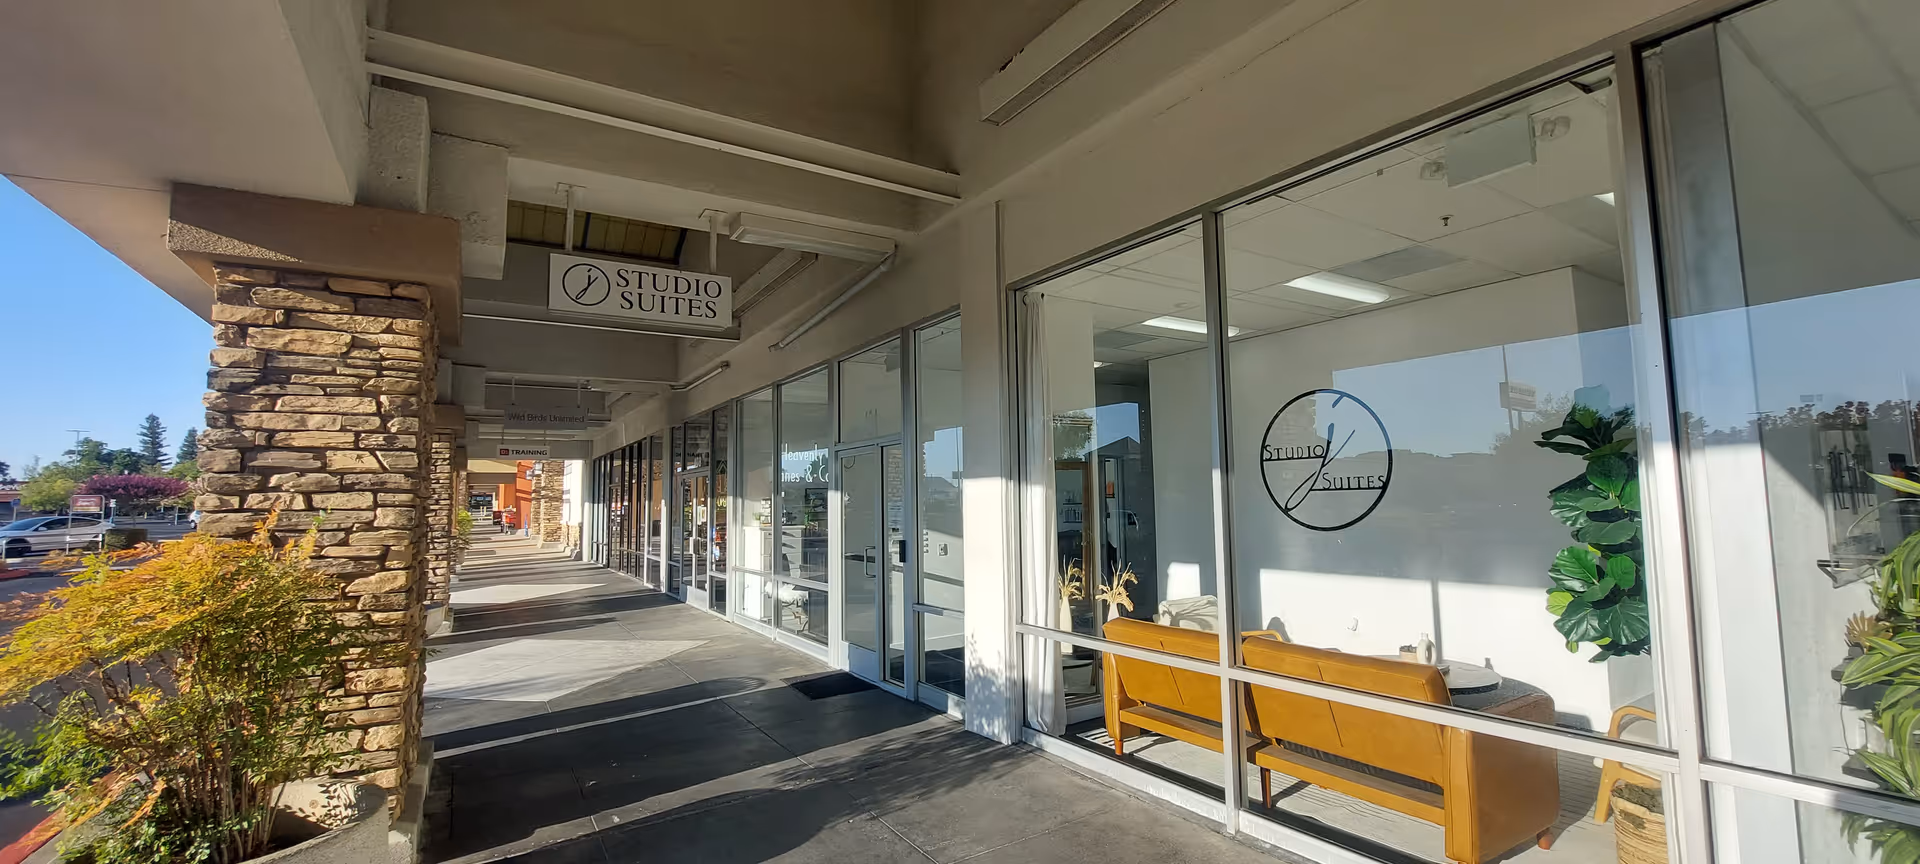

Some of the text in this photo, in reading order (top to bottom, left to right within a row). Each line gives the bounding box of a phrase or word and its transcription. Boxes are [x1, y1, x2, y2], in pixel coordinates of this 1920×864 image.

[616, 268, 722, 299] STUDIO
[620, 291, 717, 319] SUITES
[527, 413, 547, 422] Birds
[549, 414, 585, 423] Unlimited
